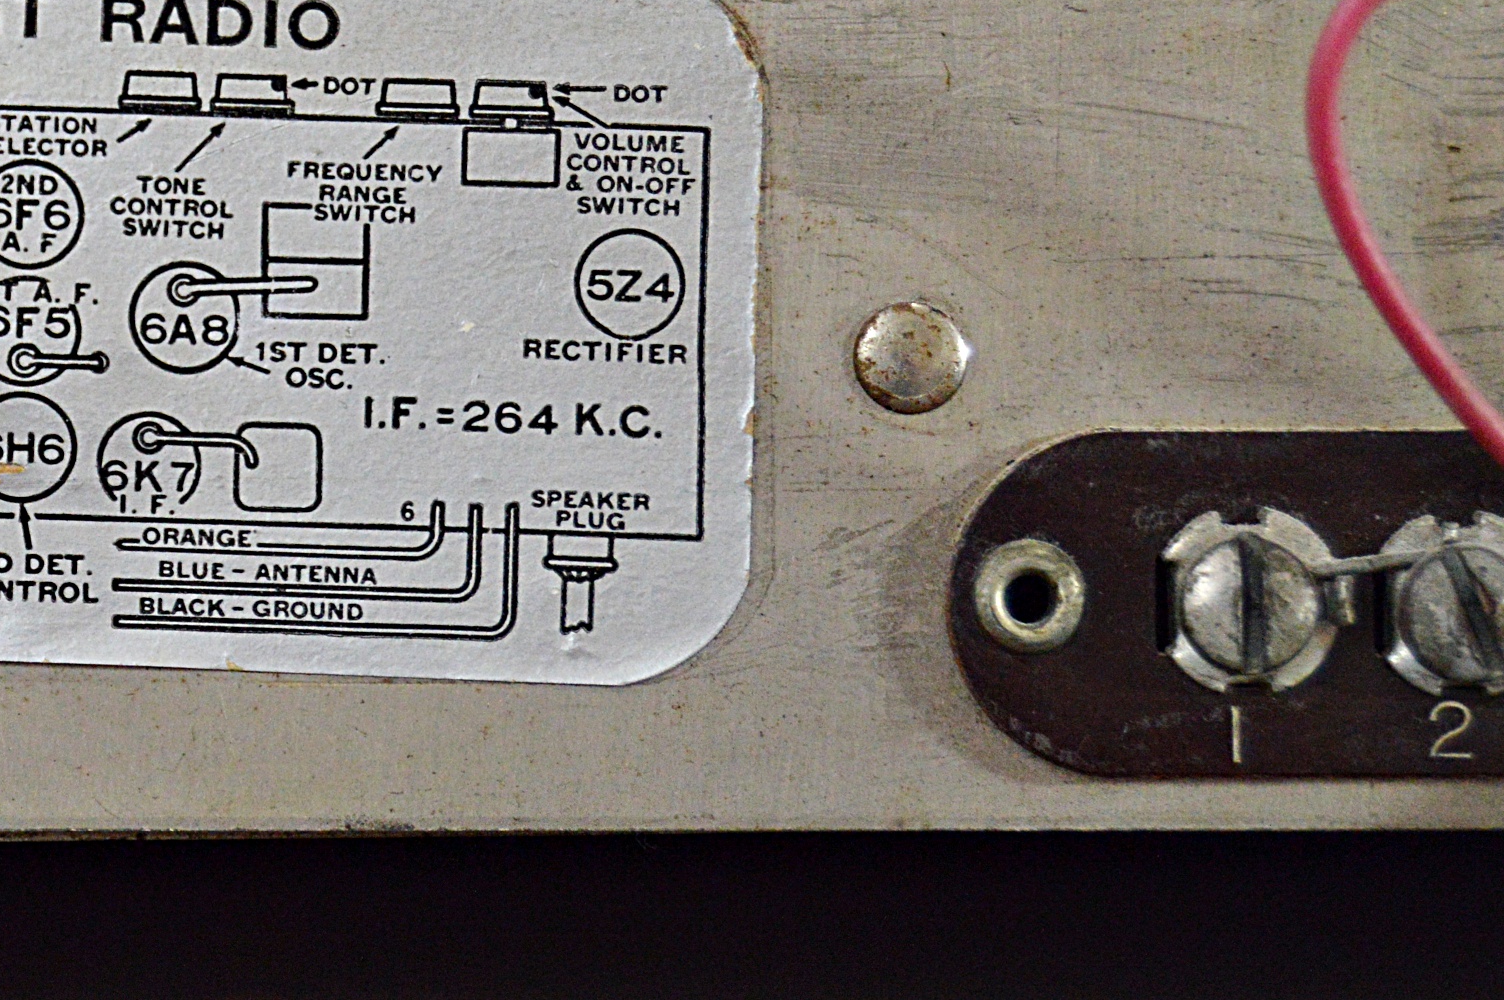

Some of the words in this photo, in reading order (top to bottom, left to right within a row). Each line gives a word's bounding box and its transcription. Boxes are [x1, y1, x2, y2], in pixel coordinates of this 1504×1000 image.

[323, 76, 377, 96] DOT
[613, 83, 668, 104] DOT
[574, 132, 685, 154] VOLUME
[287, 161, 443, 183] FREQUENCY
[566, 154, 691, 176] CONTROL
[0, 174, 59, 196] 2ND
[136, 175, 206, 196] TONE
[319, 184, 407, 205] RANGE
[565, 174, 584, 192] &
[598, 175, 697, 196] ON-OFF
[109, 196, 234, 219] CONTROL
[313, 204, 416, 224] SWITCH
[576, 196, 681, 217] SWITCH
[122, 220, 225, 240] SWITCH
[586, 269, 675, 304] 5Z4
[139, 313, 229, 346] 6A8
[255, 341, 308, 362] 1ST
[318, 342, 386, 365] DET.
[522, 338, 688, 365] RECTIFIER
[285, 366, 353, 391] OSC.
[102, 461, 195, 493] 6K7
[400, 500, 415, 522] 6
[530, 489, 651, 511] SPEAKER
[555, 511, 626, 532] PLUG
[141, 526, 252, 548] ORANGE
[24, 553, 93, 576] DET.
[157, 560, 225, 581] BLUE
[254, 563, 377, 586] ANTENNA
[138, 597, 226, 617] BLACK
[251, 599, 364, 621] GROUND
[1229, 704, 1243, 764] 1
[1428, 701, 1475, 760] 2
